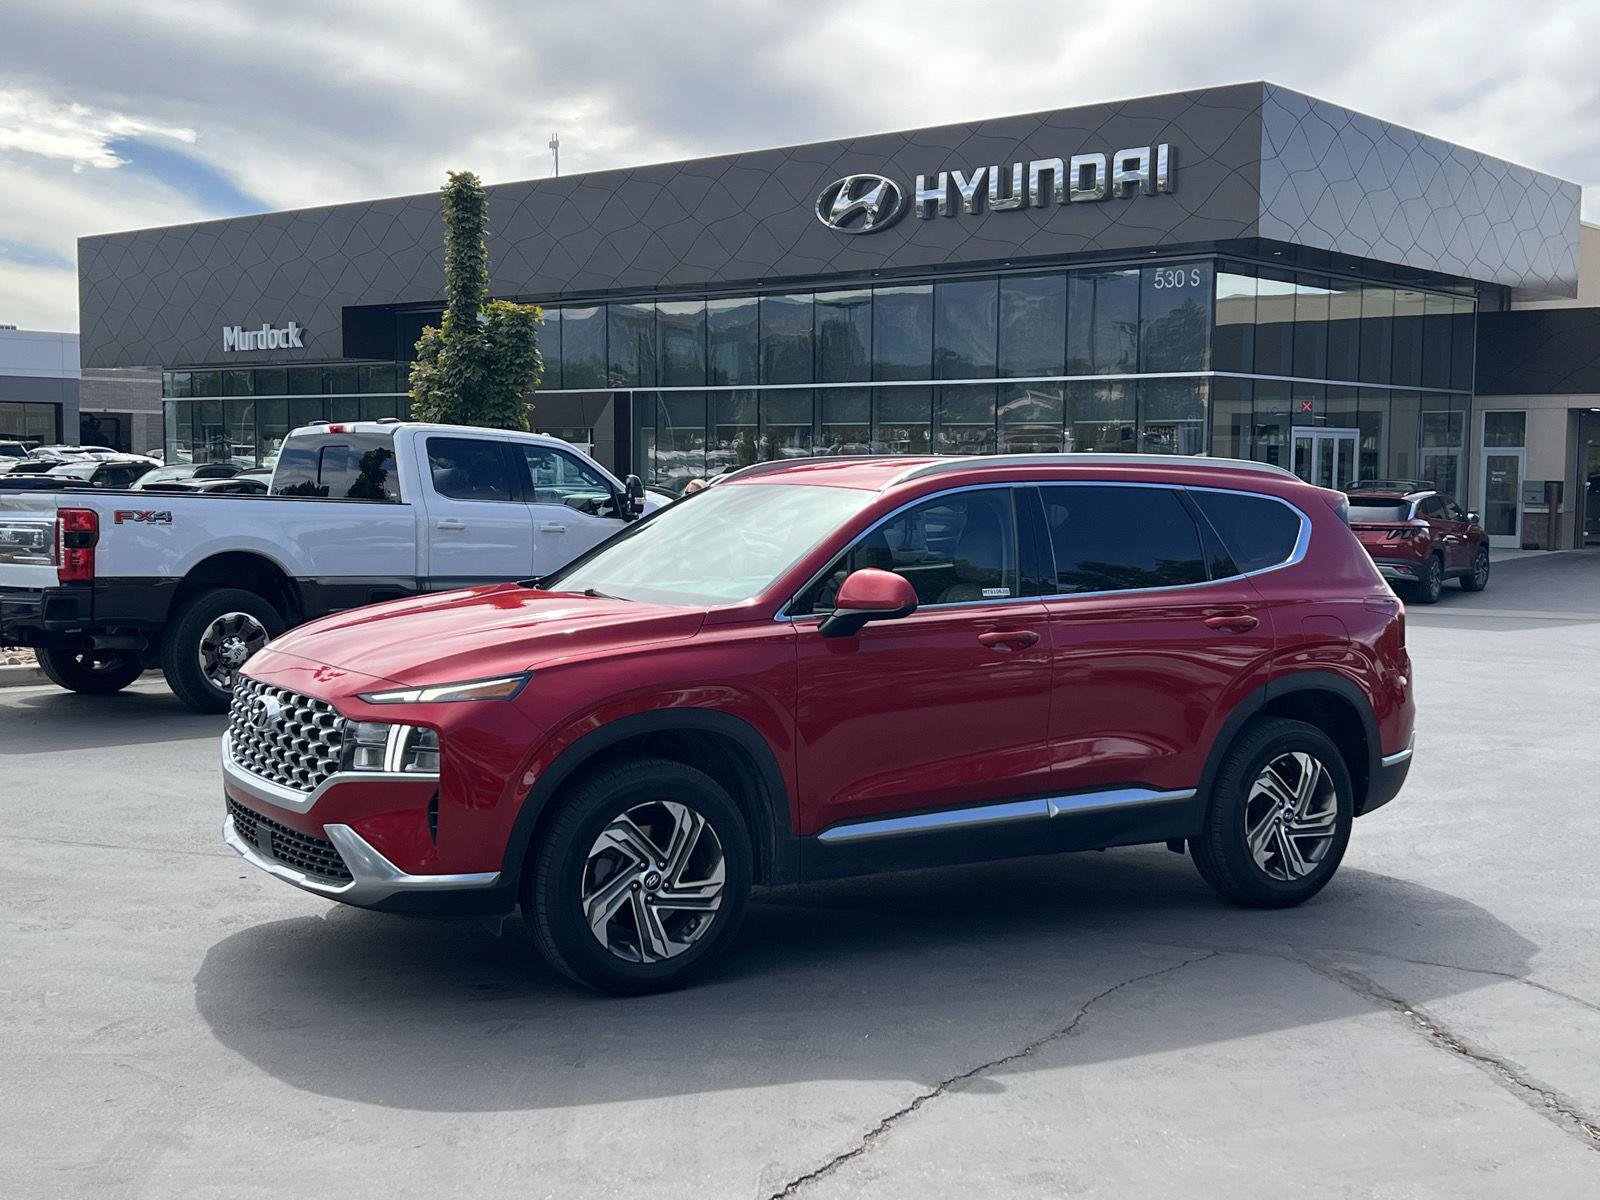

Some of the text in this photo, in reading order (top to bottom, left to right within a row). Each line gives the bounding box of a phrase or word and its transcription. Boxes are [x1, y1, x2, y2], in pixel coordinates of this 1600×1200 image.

[915, 143, 1171, 219] HYUNDAI
[1154, 268, 1200, 289] 530 S
[223, 321, 304, 352] Murdock
[114, 510, 172, 524] FX4
